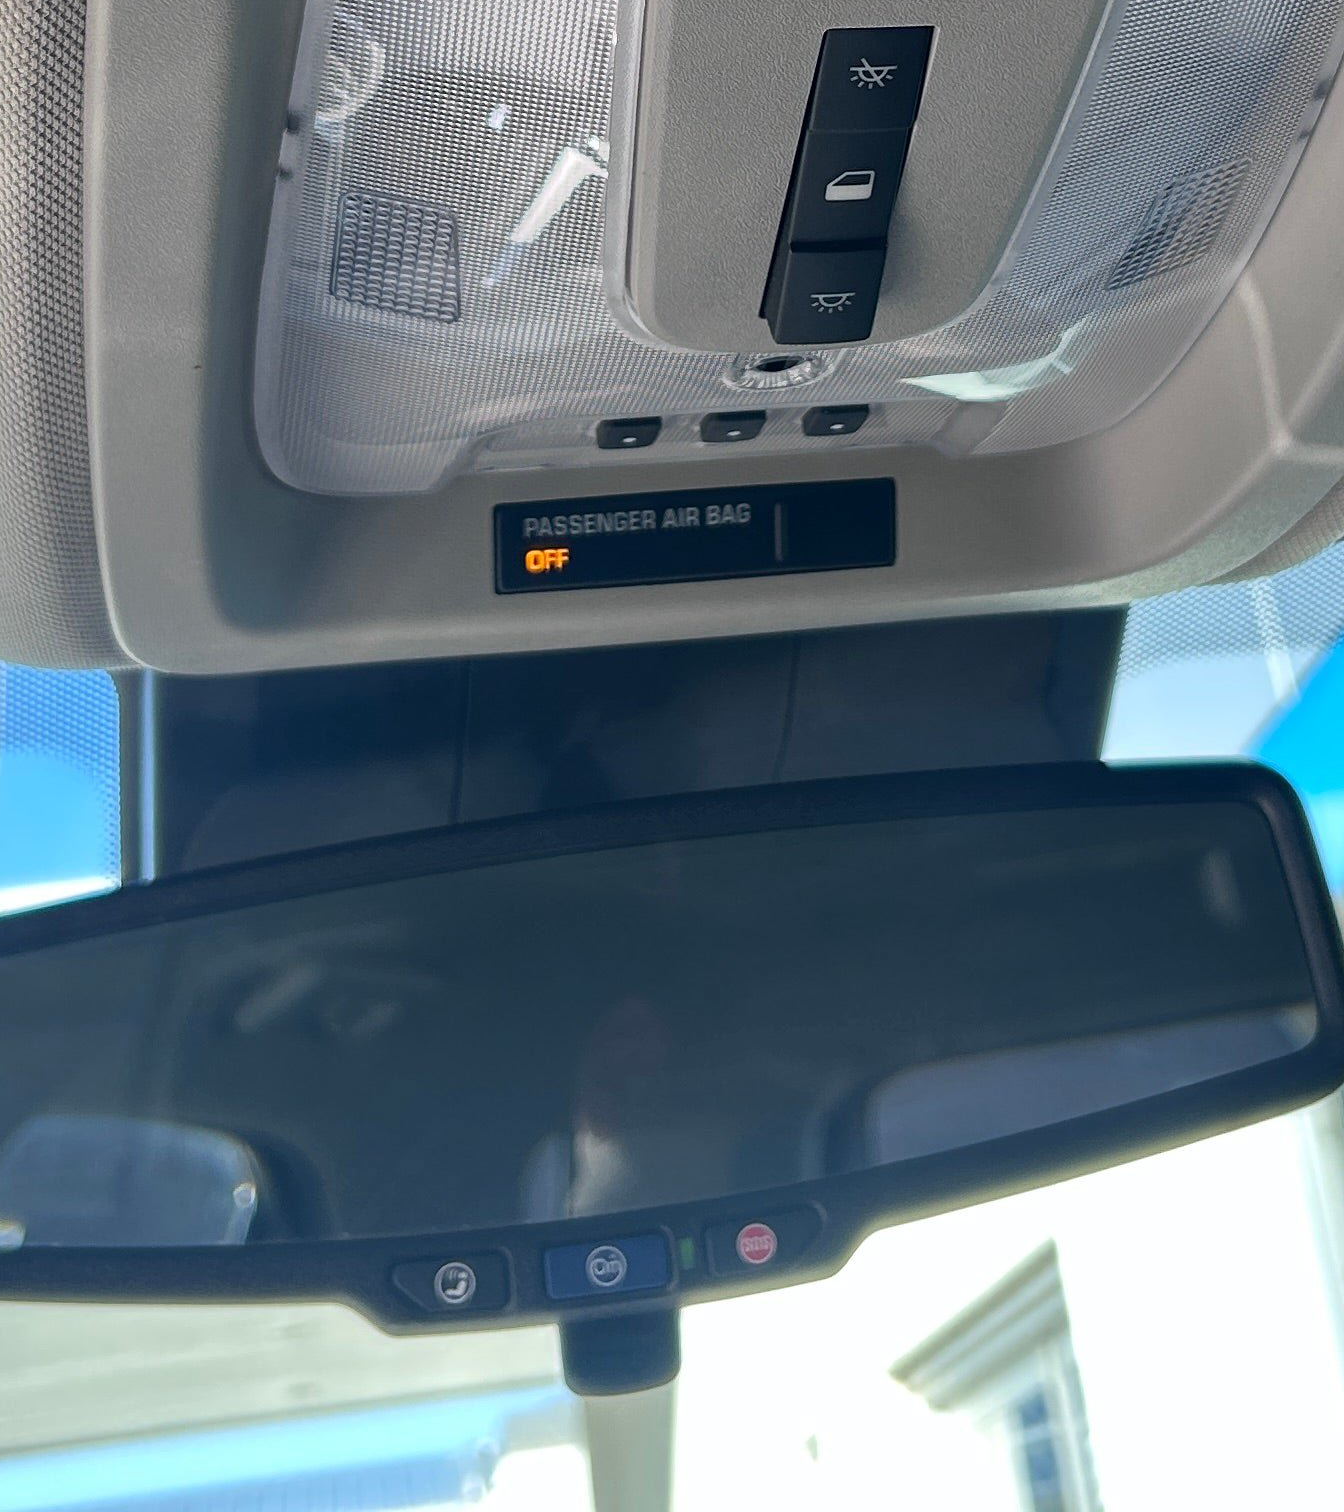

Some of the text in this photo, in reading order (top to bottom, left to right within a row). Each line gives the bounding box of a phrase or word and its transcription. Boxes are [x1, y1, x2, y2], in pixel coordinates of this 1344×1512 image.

[523, 502, 752, 538] PASSENGER AIR BAG
[525, 547, 570, 573] OFF
